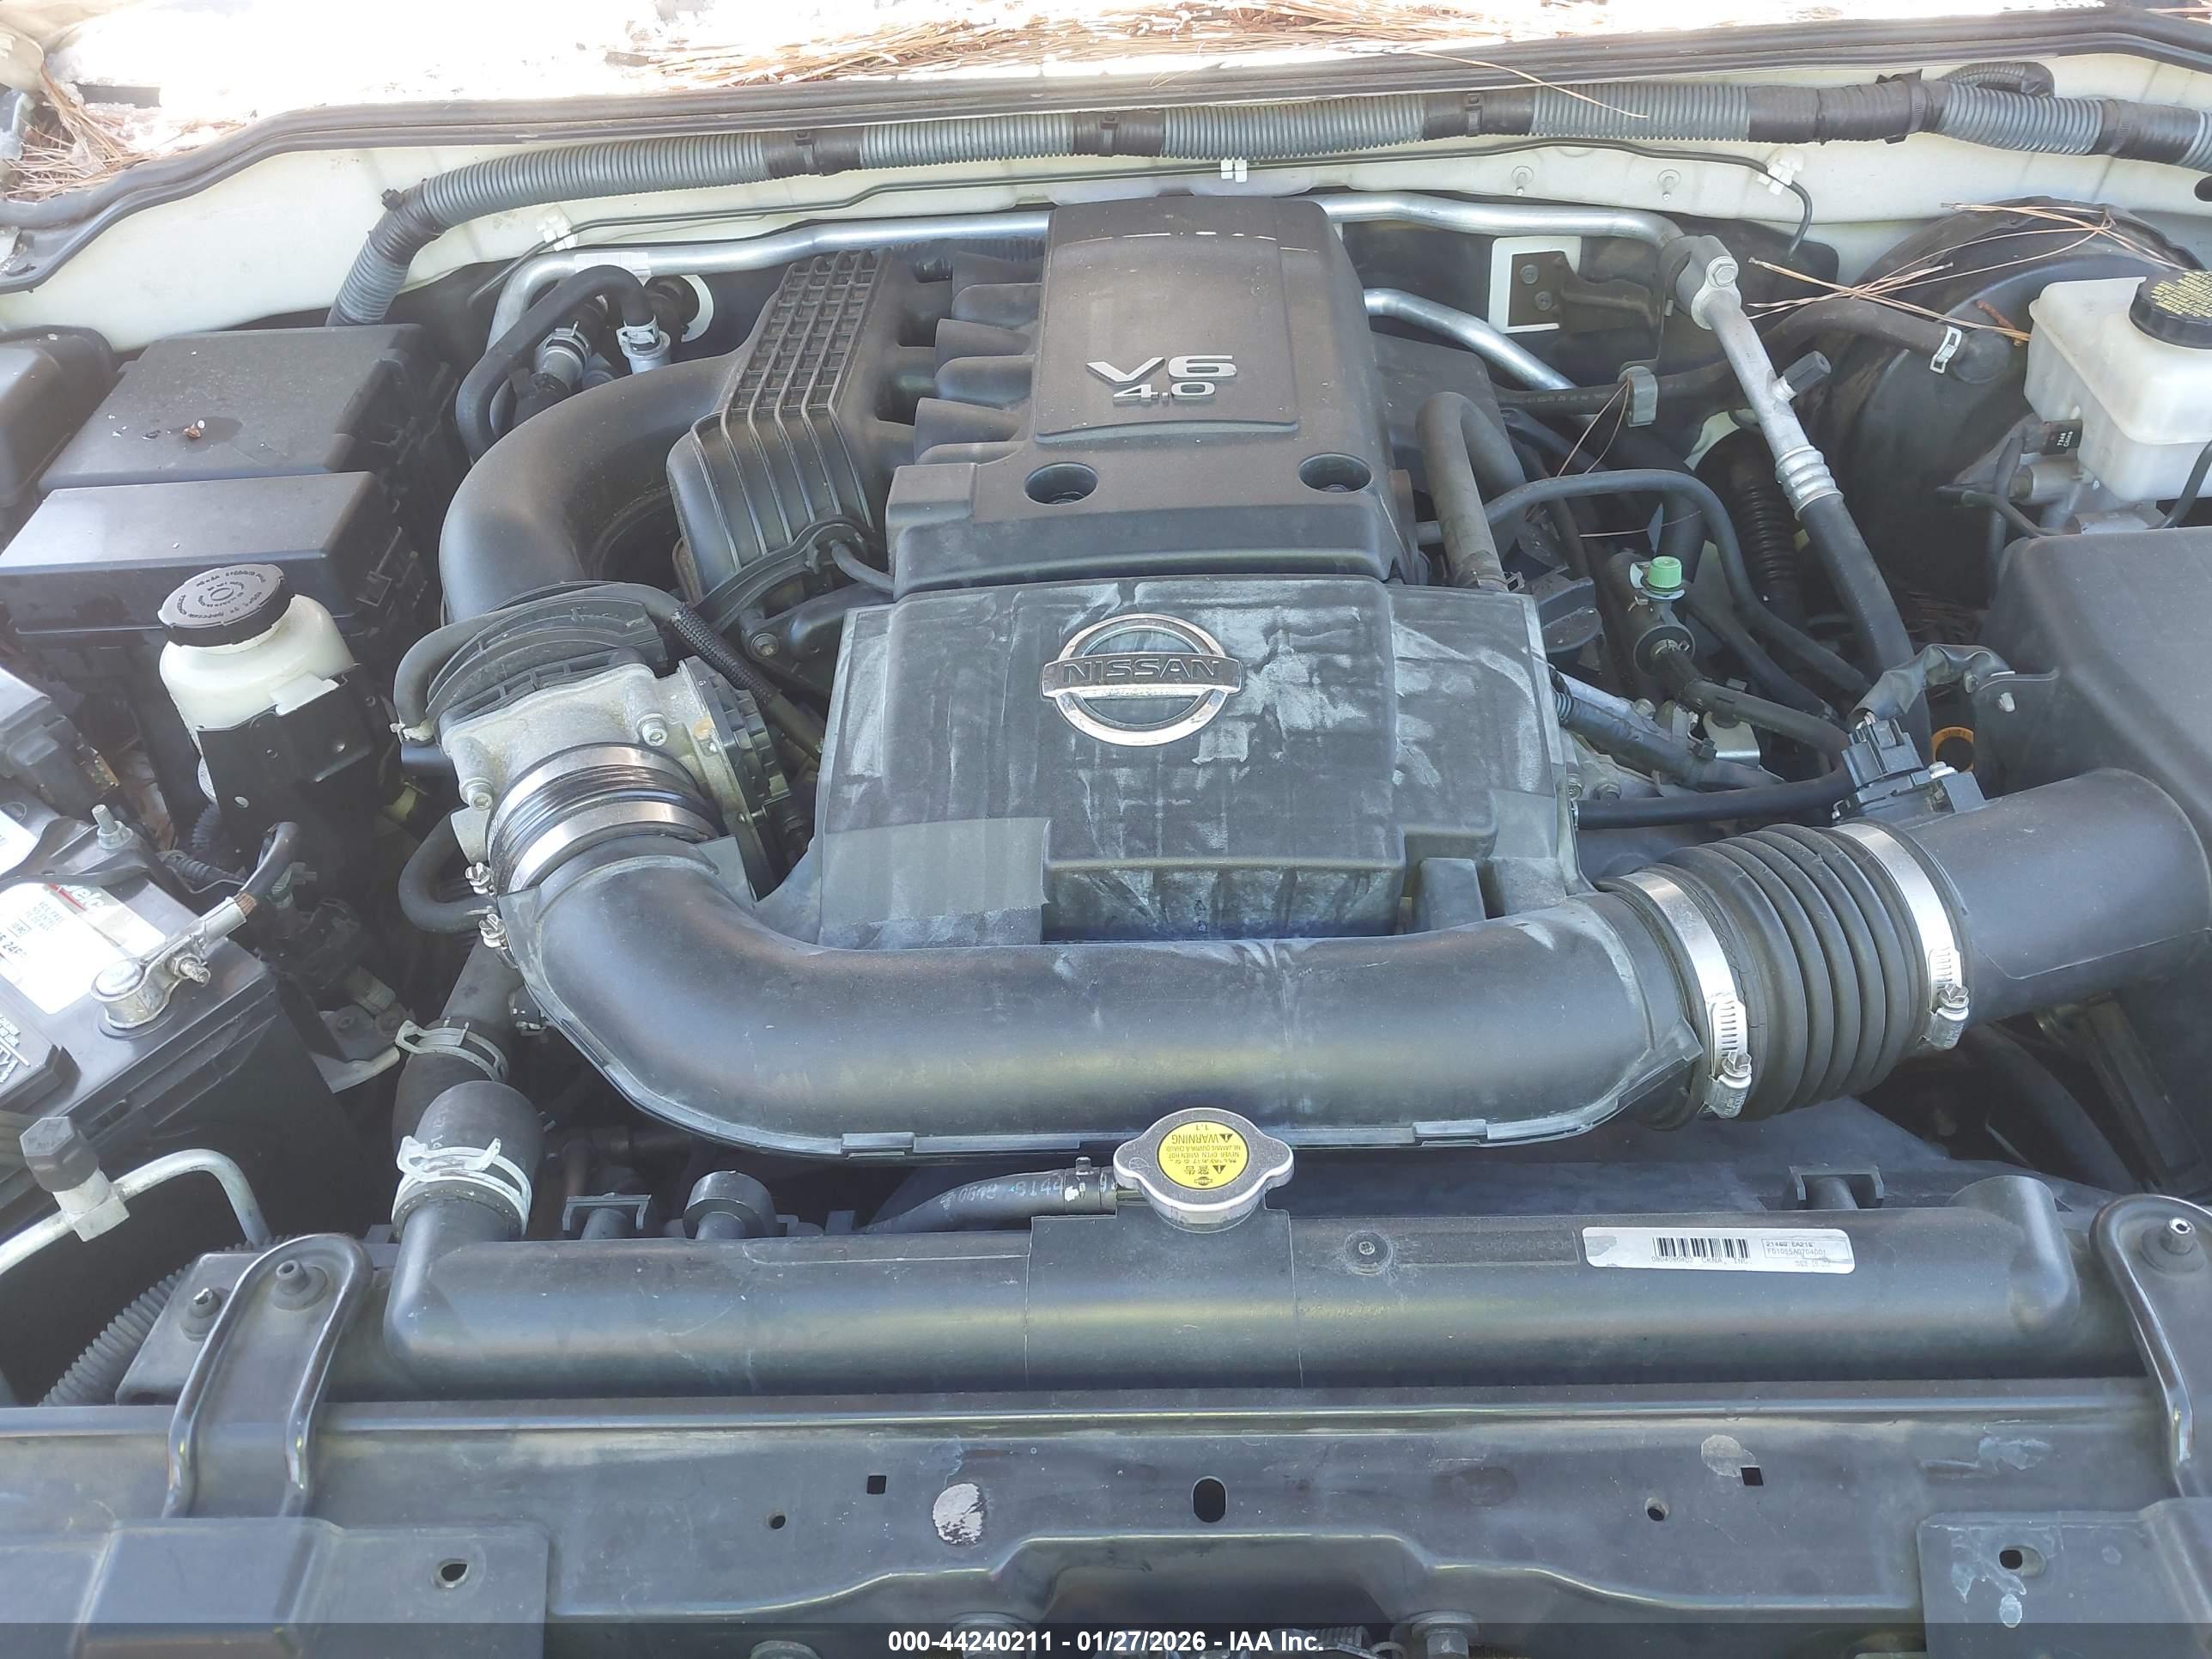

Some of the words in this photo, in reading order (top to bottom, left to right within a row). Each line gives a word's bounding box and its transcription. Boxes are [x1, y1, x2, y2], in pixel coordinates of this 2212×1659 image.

[1086, 355, 1237, 385] V6
[1113, 382, 1216, 405] 4.0
[1063, 659, 1219, 683] NISSAN
[1171, 1133, 1218, 1145] WARNING
